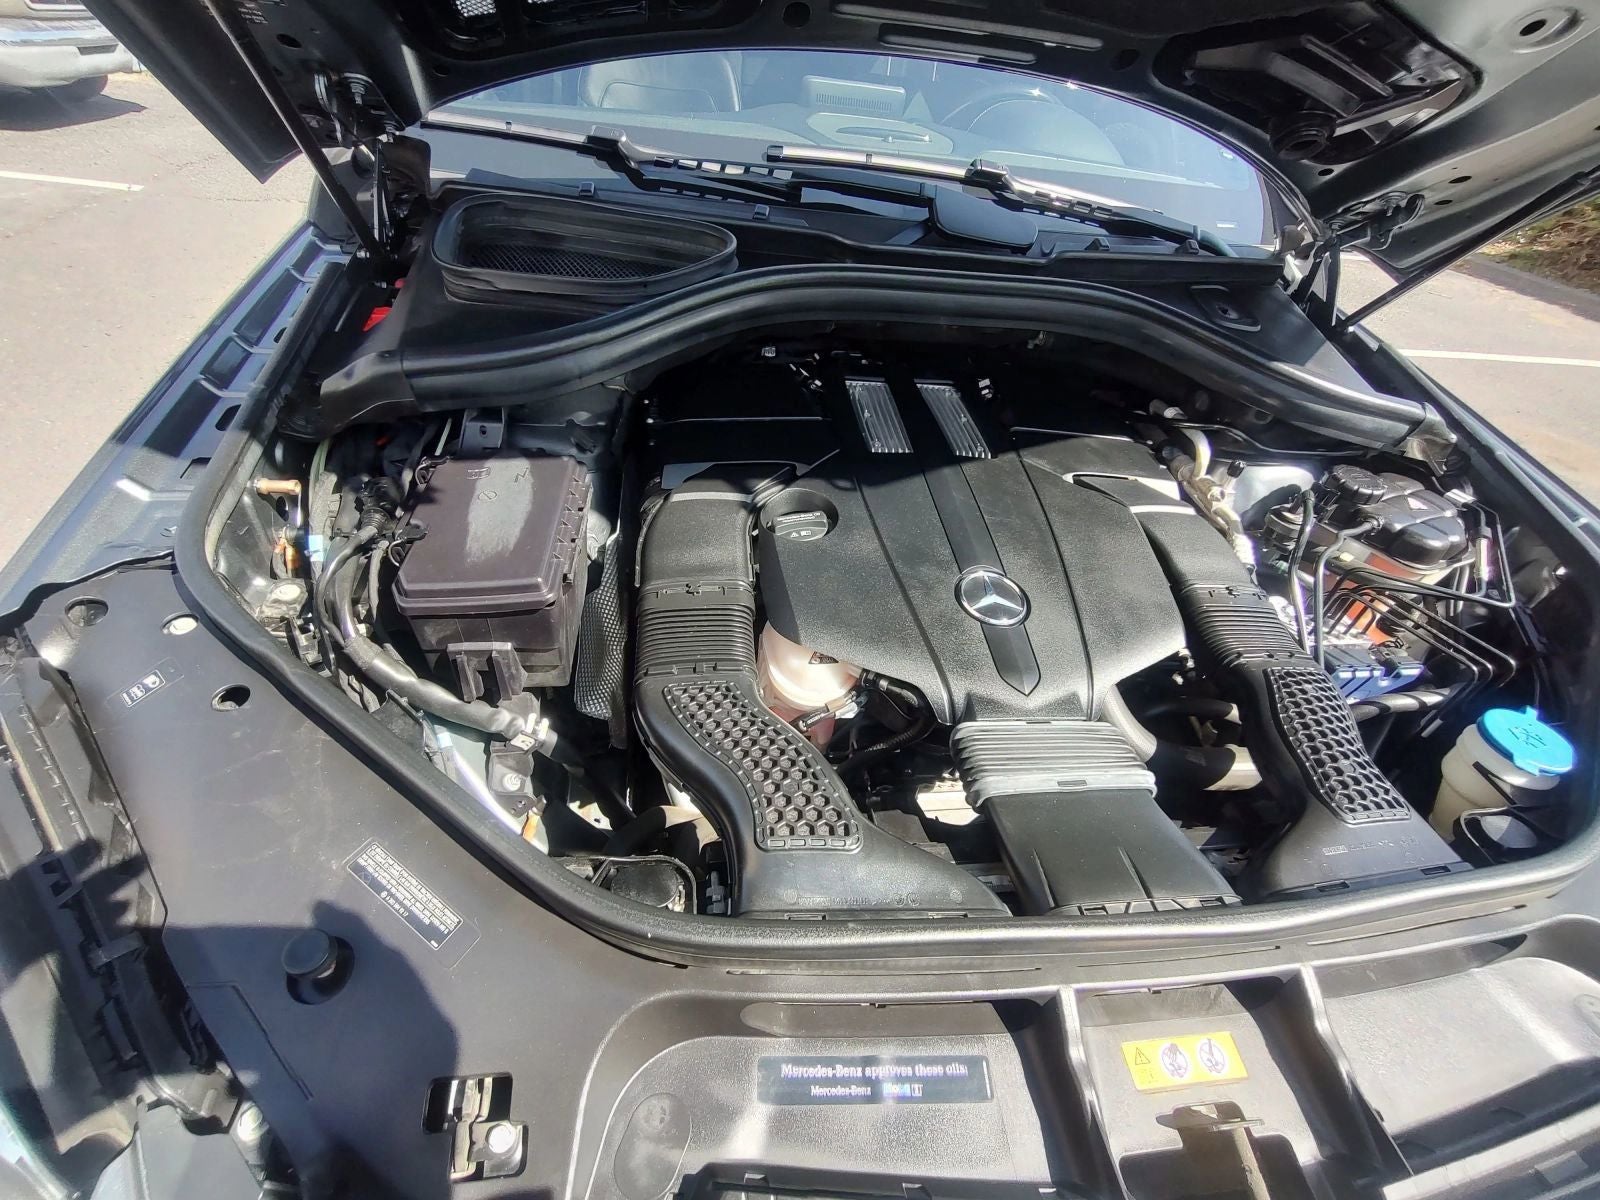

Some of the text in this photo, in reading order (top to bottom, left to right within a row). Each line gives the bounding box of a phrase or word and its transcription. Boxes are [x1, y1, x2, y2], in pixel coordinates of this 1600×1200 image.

[780, 1063, 863, 1078] Mercedes-Benz
[864, 1064, 913, 1080] approves
[914, 1063, 944, 1077] these
[810, 1085, 872, 1097] Mercedes-Benz
